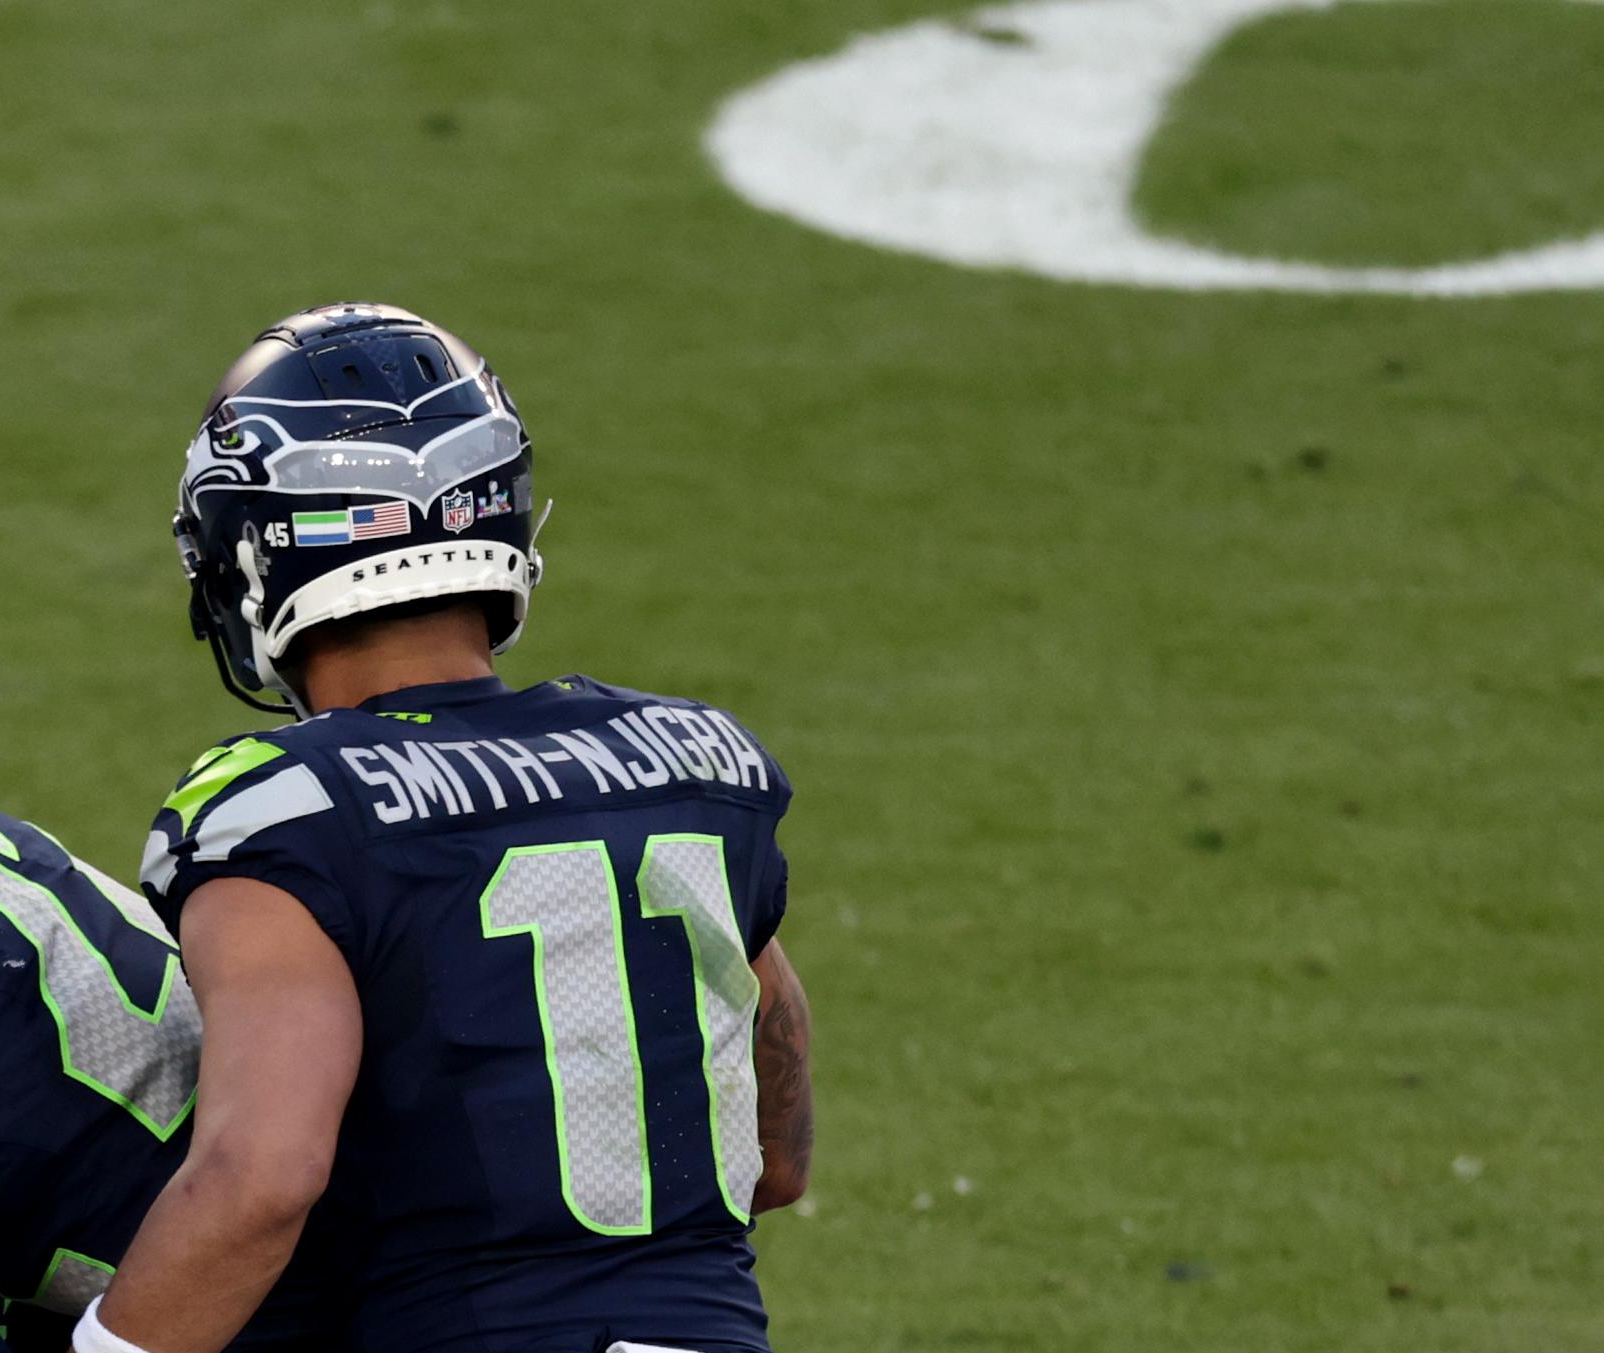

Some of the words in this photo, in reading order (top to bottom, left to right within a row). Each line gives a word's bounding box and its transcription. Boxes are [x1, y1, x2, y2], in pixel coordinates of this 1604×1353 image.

[263, 522, 290, 547] 45
[447, 508, 471, 528] NFL
[352, 549, 494, 583] SEATTLE
[340, 705, 770, 825] SMITH-NJIGBA
[480, 833, 764, 1236] 11
